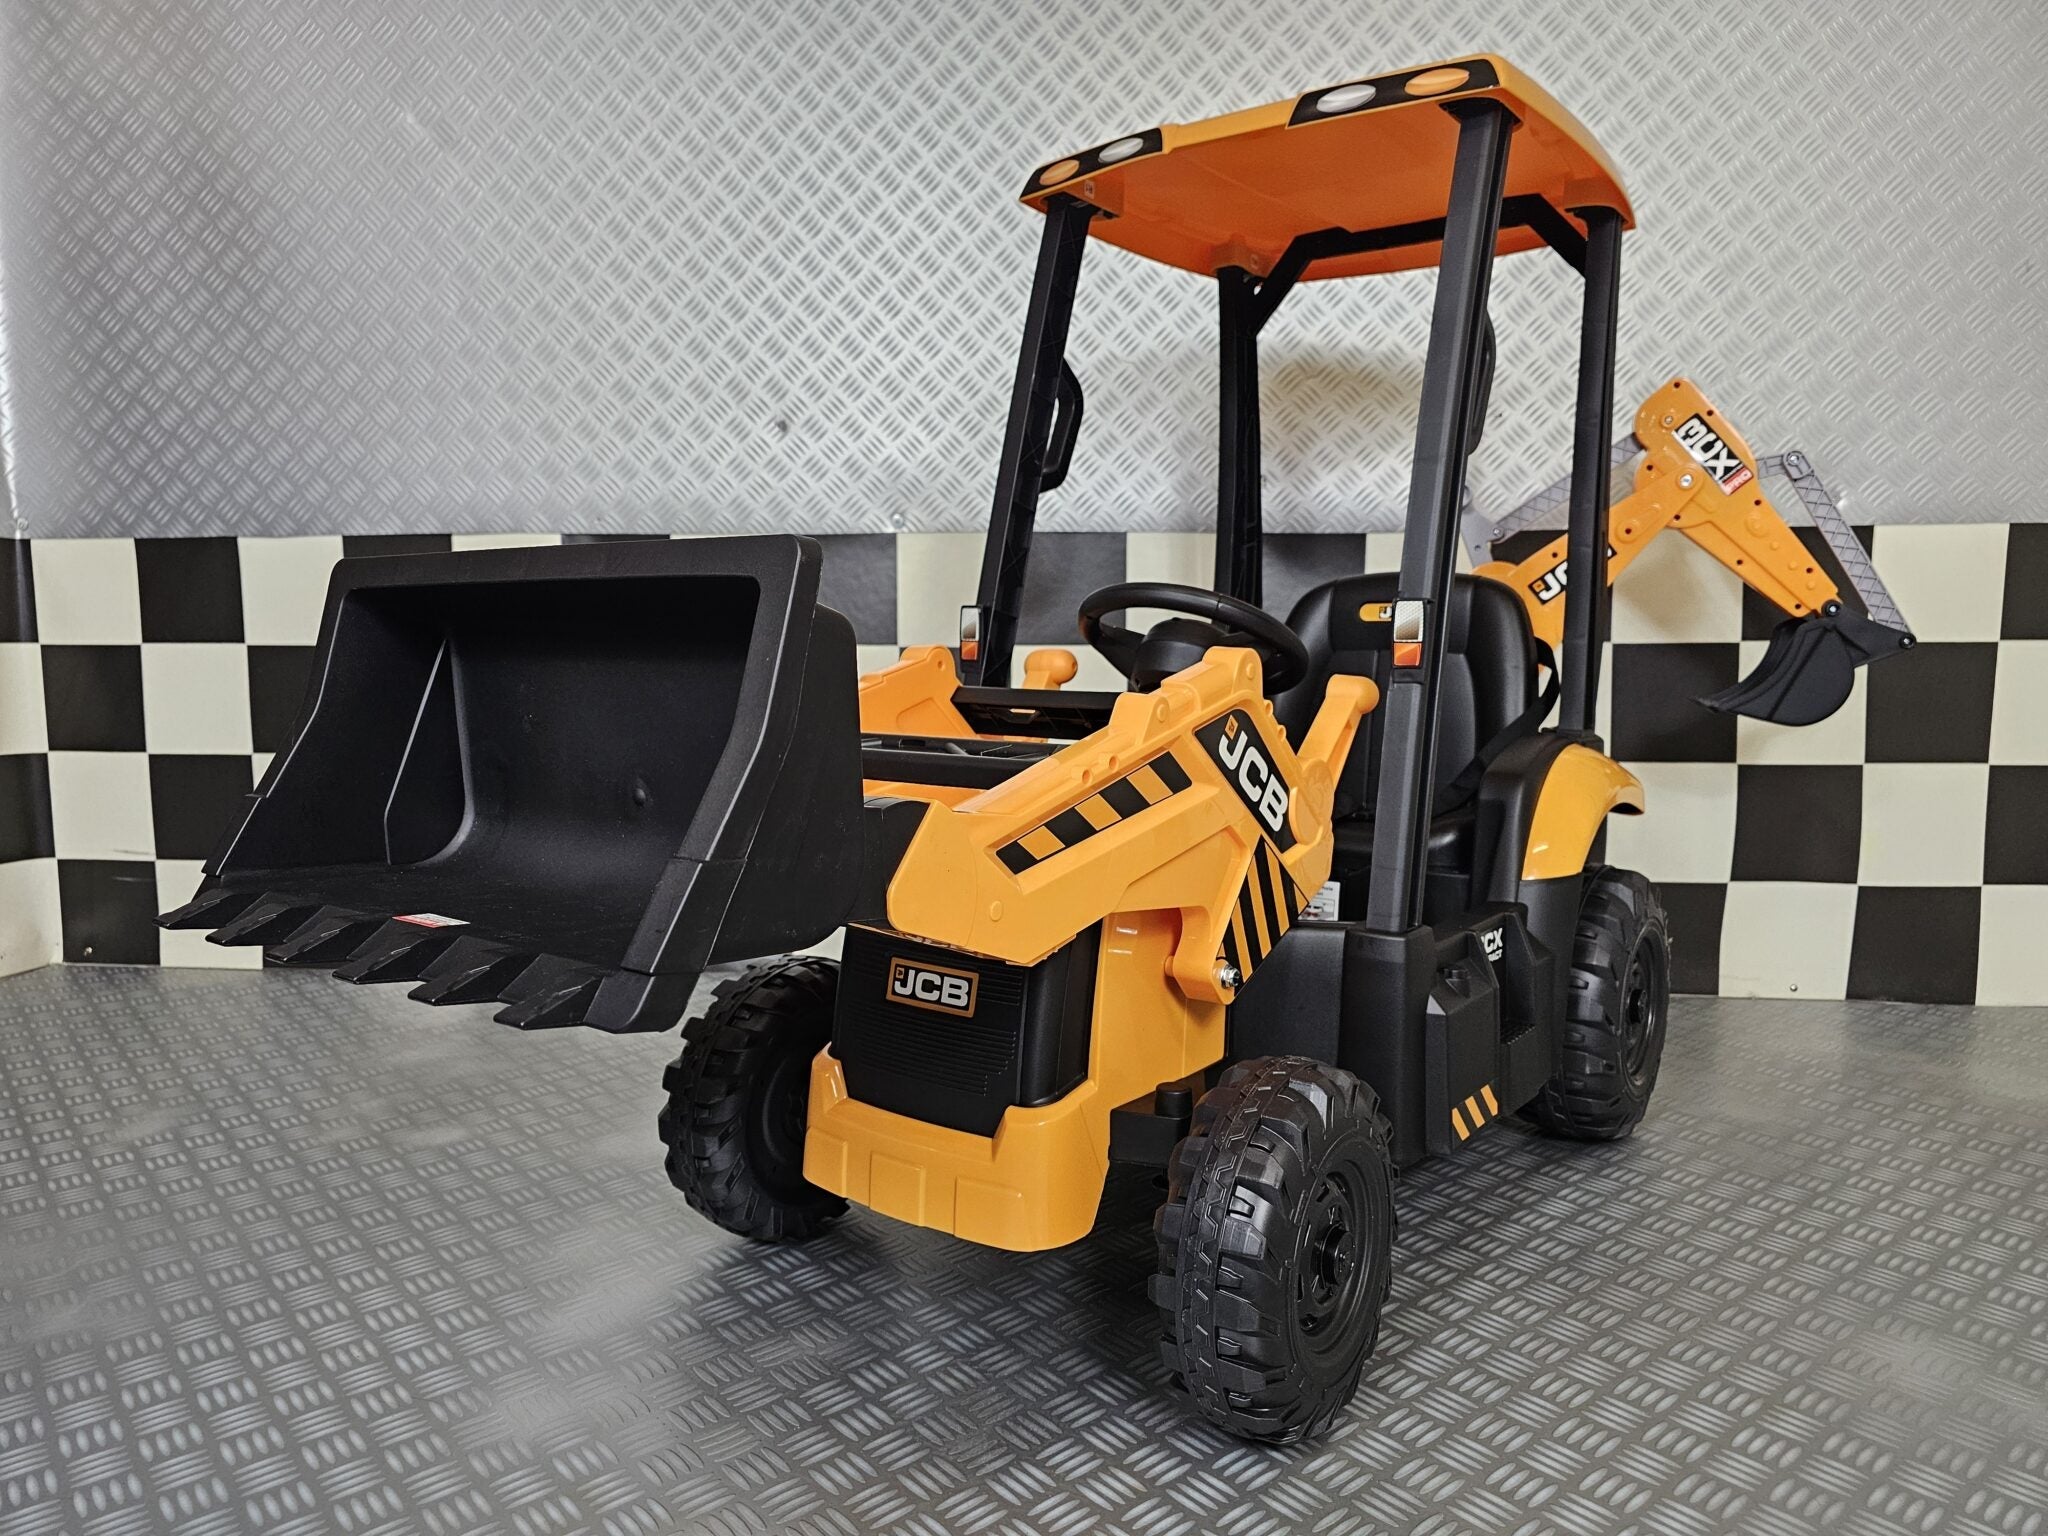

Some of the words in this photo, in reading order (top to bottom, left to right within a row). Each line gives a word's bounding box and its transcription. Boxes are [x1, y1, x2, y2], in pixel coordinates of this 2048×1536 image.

[1677, 417, 1740, 480] 3CX
[1218, 730, 1288, 832] JCB
[894, 969, 969, 1007] JCB
